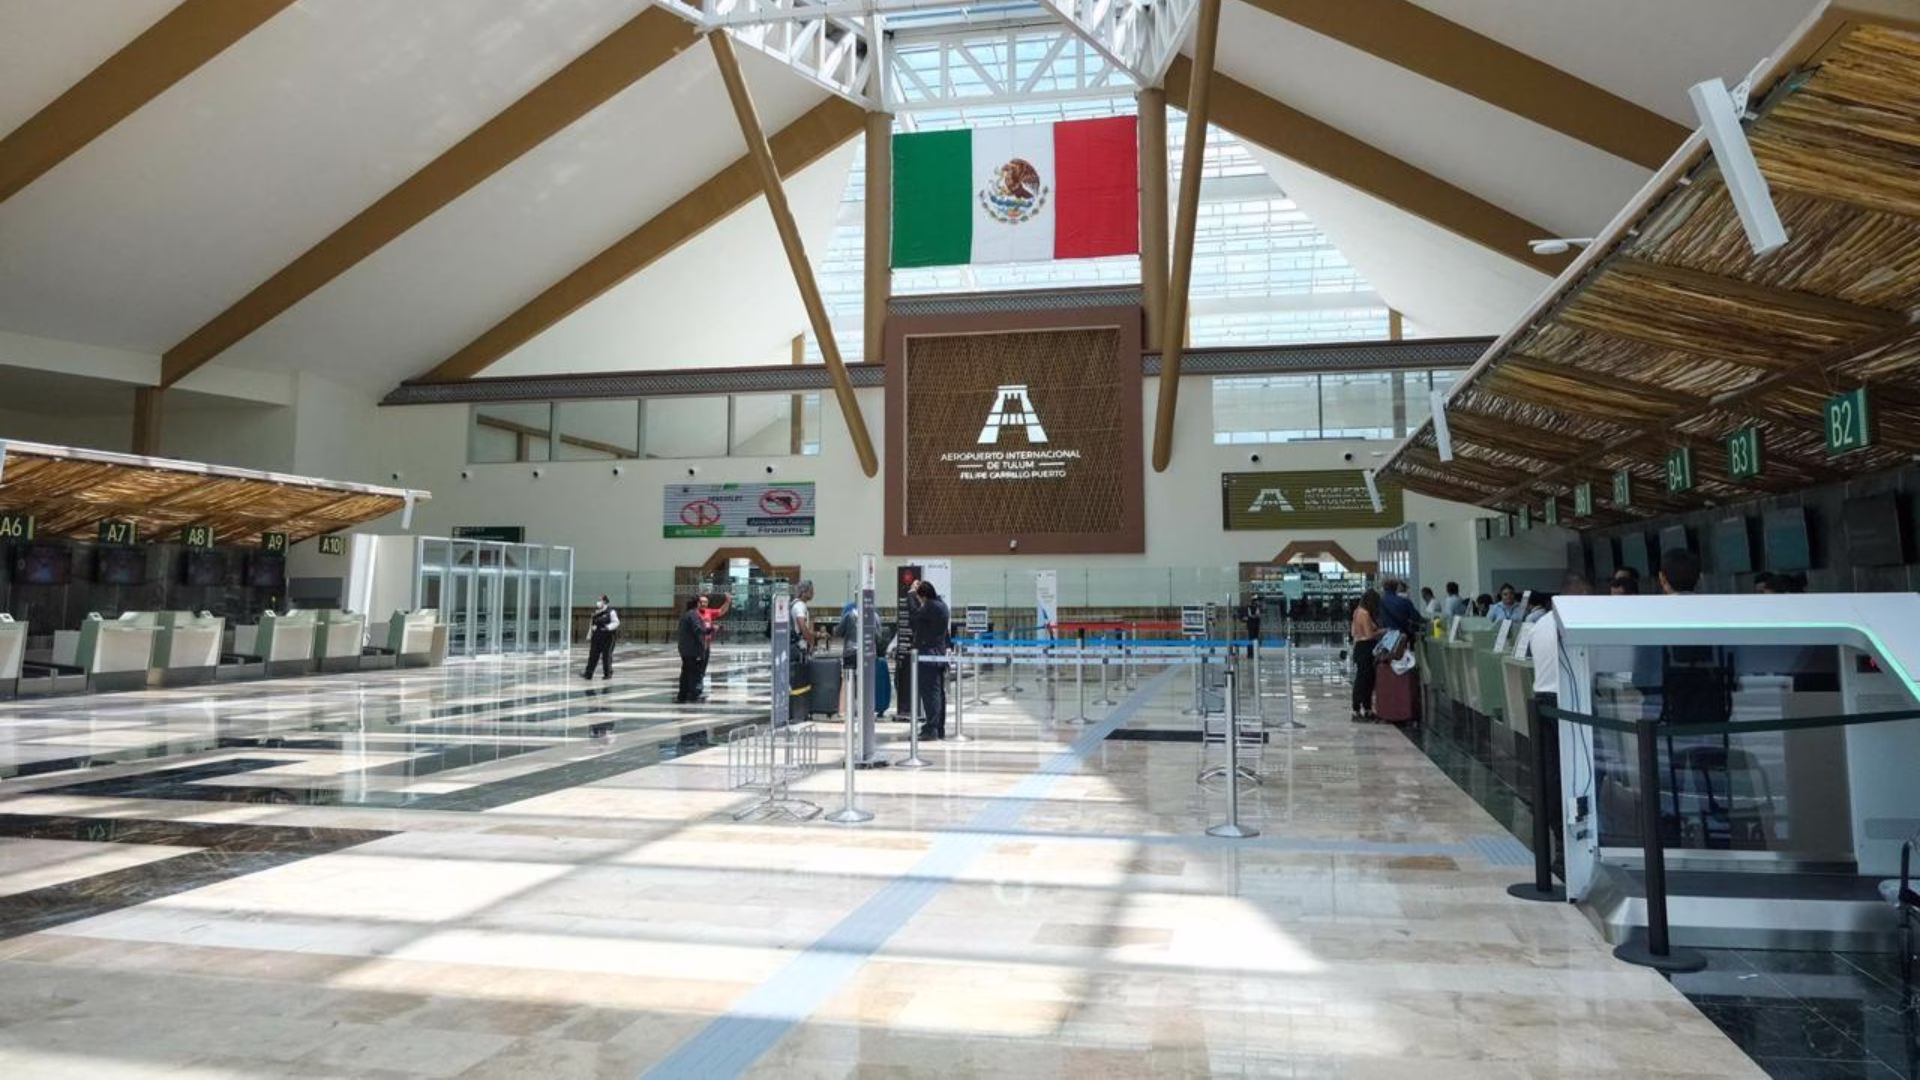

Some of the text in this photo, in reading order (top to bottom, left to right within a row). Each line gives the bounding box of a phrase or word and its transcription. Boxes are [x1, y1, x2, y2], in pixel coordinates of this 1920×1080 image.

[1831, 400, 1853, 448] B2
[941, 449, 1081, 461] AEROPUERTO INTERNACIONAL
[1731, 436, 1748, 475] B3
[986, 460, 1035, 470] DE TULUM
[1668, 457, 1683, 491] B4
[960, 470, 1067, 480] FELIPE CARRILLO PUERTO
[0, 516, 22, 537] A6
[107, 524, 126, 543] A7
[188, 528, 205, 546] A8
[267, 534, 284, 550] A9
[322, 537, 340, 553] A10
